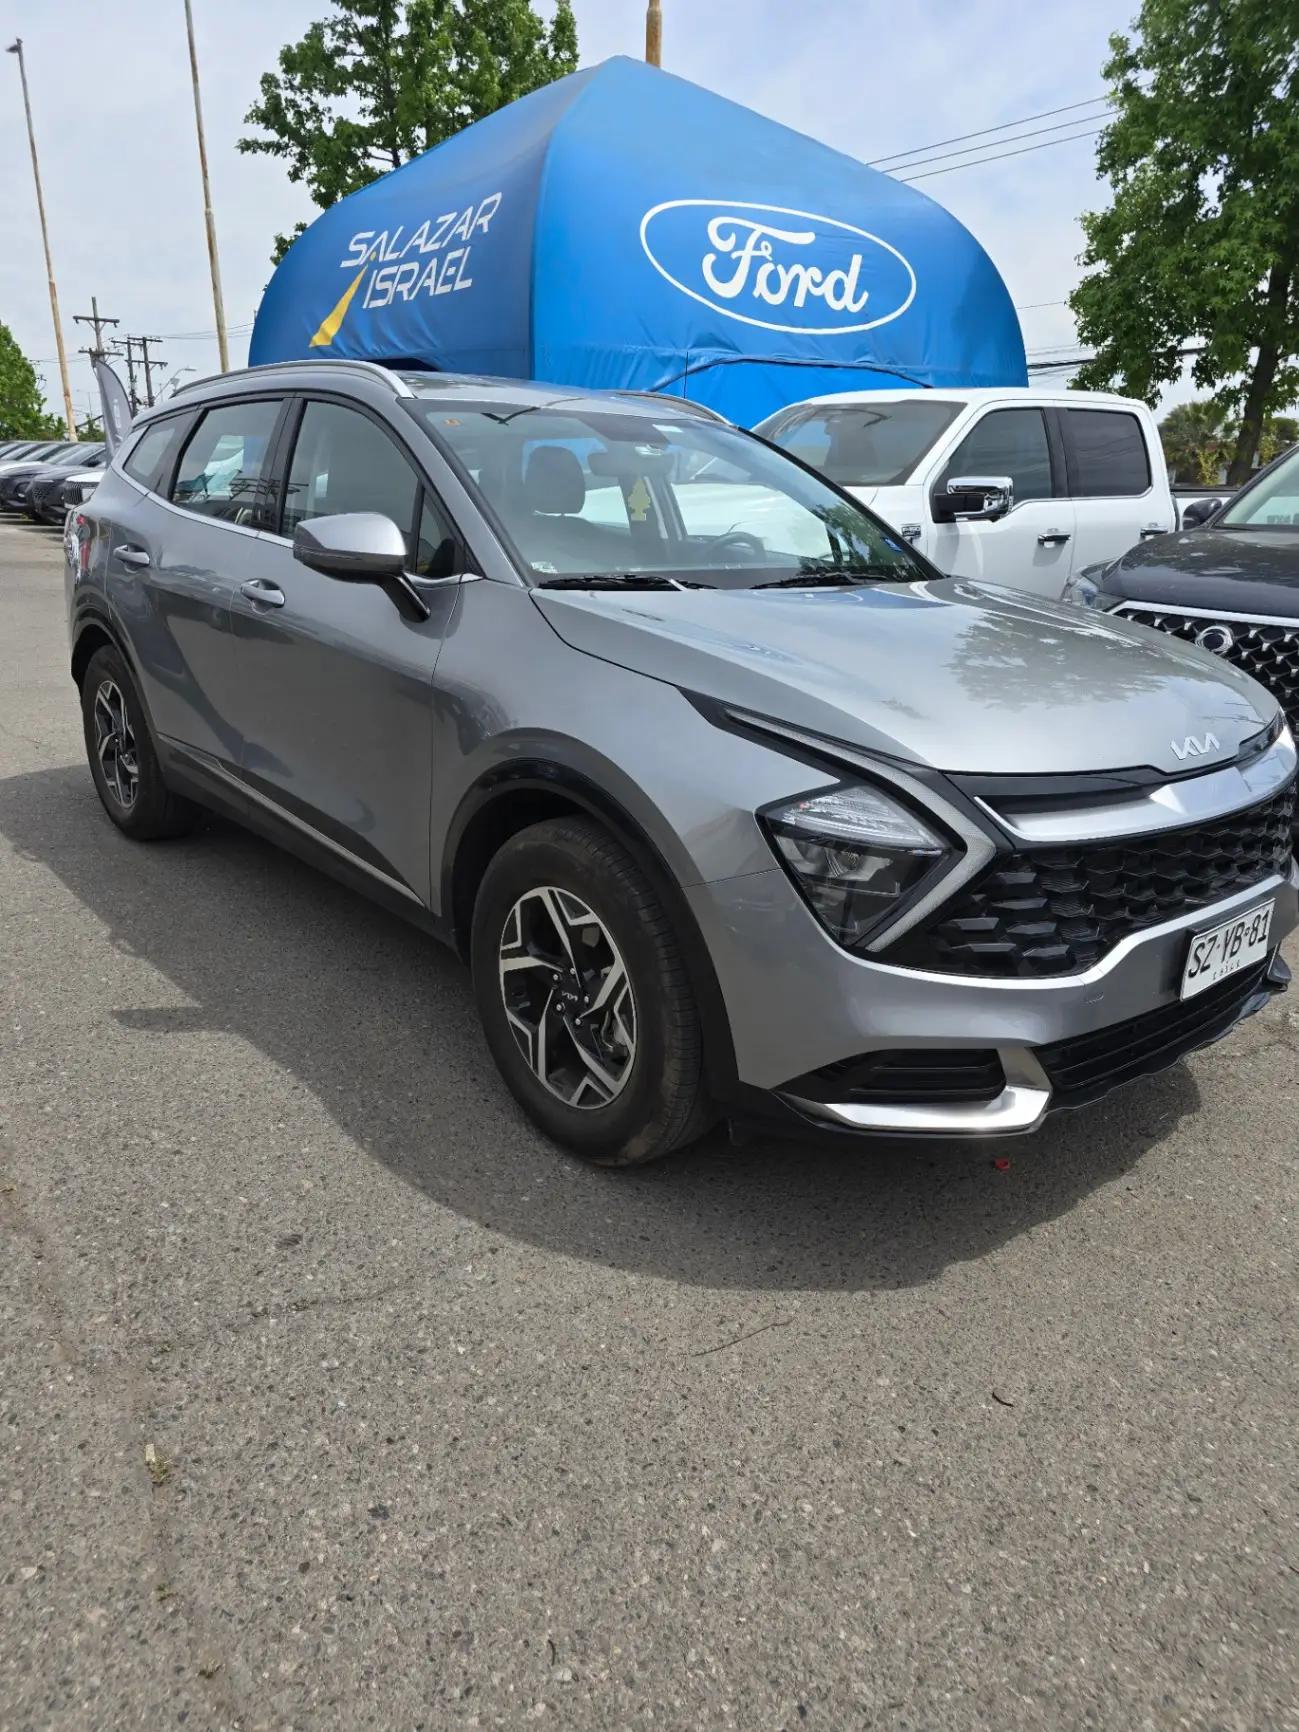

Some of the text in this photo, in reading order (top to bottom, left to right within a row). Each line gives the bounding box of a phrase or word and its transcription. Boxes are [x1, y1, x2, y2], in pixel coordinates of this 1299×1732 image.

[339, 192, 502, 268] SALAZAR
[702, 216, 869, 313] Ford
[362, 245, 473, 309] ISRAEL
[1170, 732, 1220, 760] KIA
